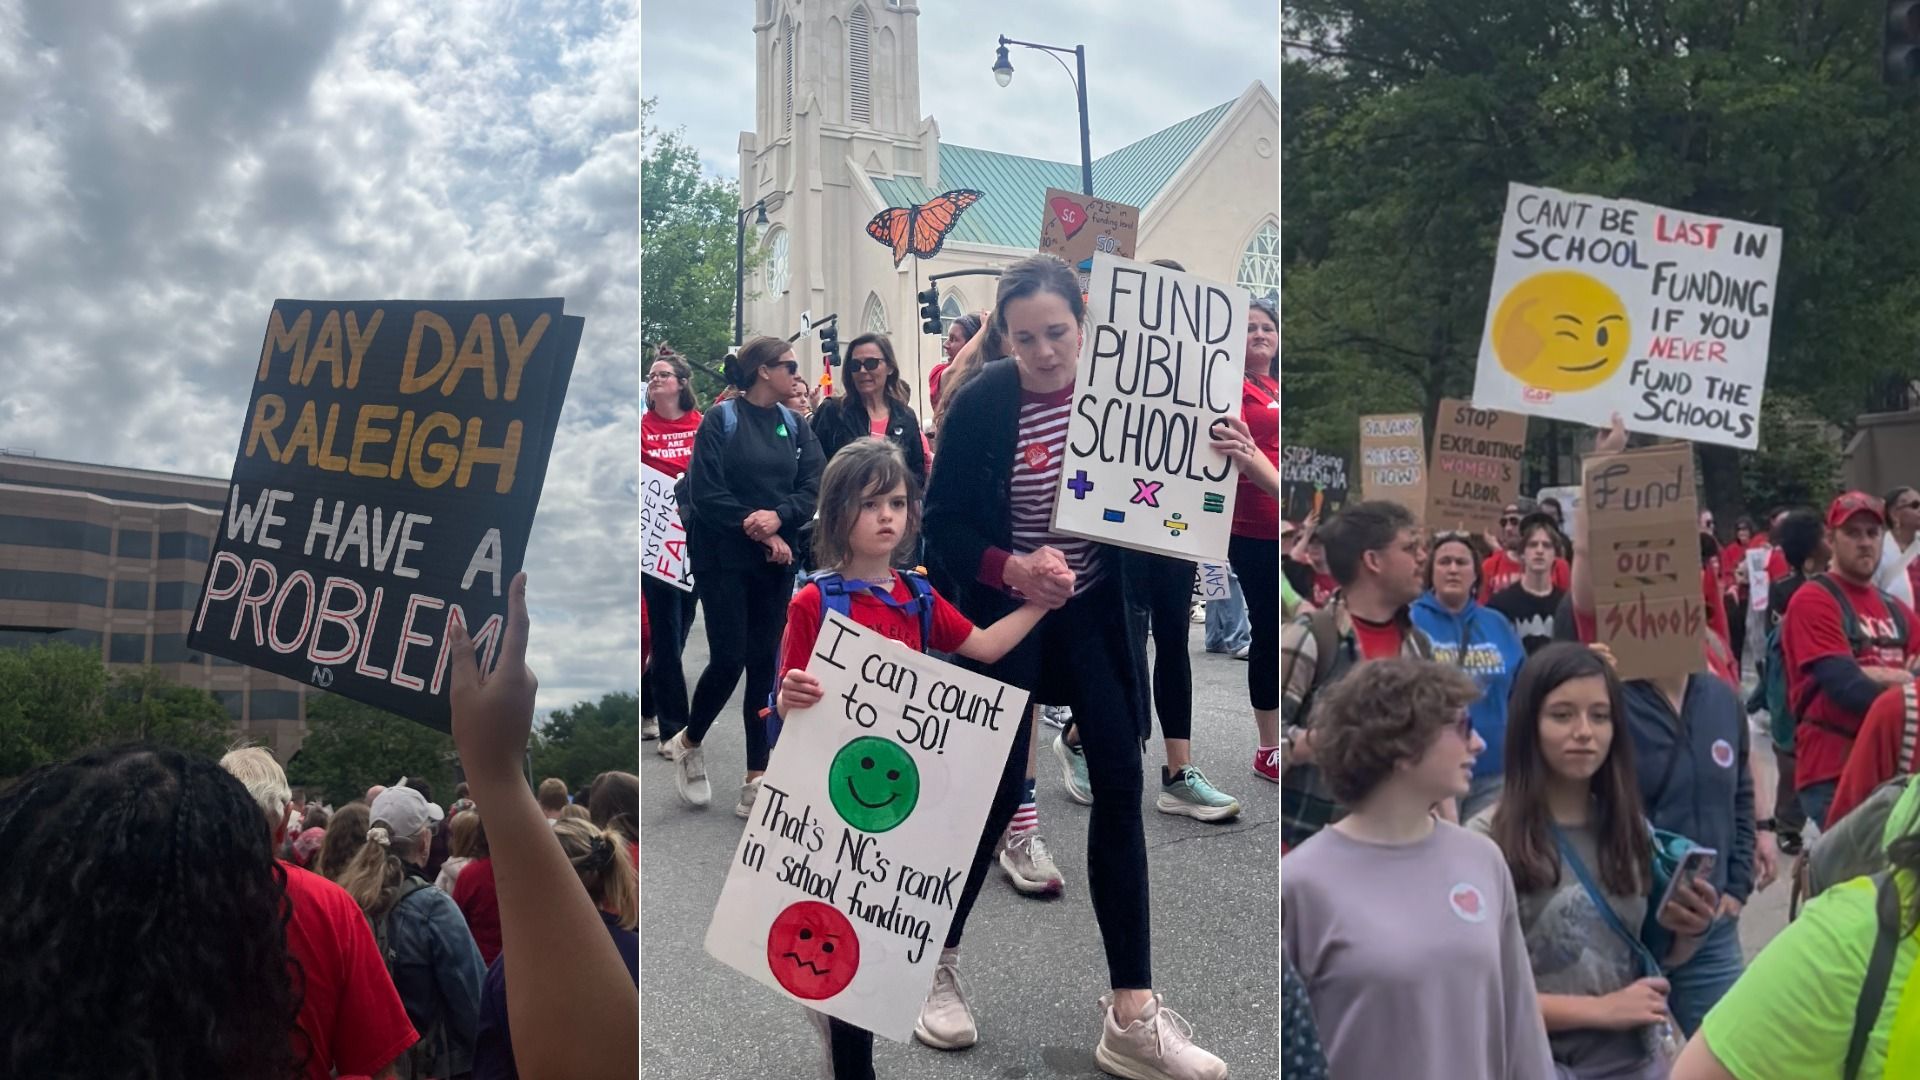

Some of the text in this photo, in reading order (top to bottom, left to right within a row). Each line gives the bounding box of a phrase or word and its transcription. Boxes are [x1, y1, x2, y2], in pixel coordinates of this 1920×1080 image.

[1062, 208, 1076, 223] SC
[1516, 194, 1768, 259] CAN'T BE LAST IN
[1512, 229, 1769, 317] SCHOOL FUNDING
[1109, 267, 1233, 346] FUND
[1650, 308, 1751, 340] IF YOU
[258, 308, 552, 401] MAY DAY
[1088, 325, 1231, 414] PUBLIC
[1649, 337, 1728, 363] NEVER
[1629, 360, 1752, 406] FUND THE
[646, 433, 660, 441] MY
[1070, 394, 1233, 483] SCHOOLS
[1366, 419, 1419, 436] SALARY
[1455, 407, 1499, 430] STOP
[1633, 391, 1755, 439] SCHOOLS
[246, 394, 524, 494] RALEIGH
[667, 440, 684, 448] ARE
[1284, 445, 1312, 464] STOP
[1440, 433, 1522, 461] EXPLOITING
[1452, 479, 1501, 503] LABOR
[1592, 464, 1683, 511] Fund
[227, 484, 502, 597] WE HAVE A
[641, 488, 676, 571] SYSTEMS
[1617, 551, 1670, 574] our
[196, 550, 504, 695] PROBLEM
[1605, 590, 1701, 641] schools
[815, 618, 1005, 731] I can count
[841, 683, 950, 755] to 50!
[762, 783, 825, 853] That's
[835, 827, 890, 883] NC's
[742, 834, 935, 965] in school funding.
